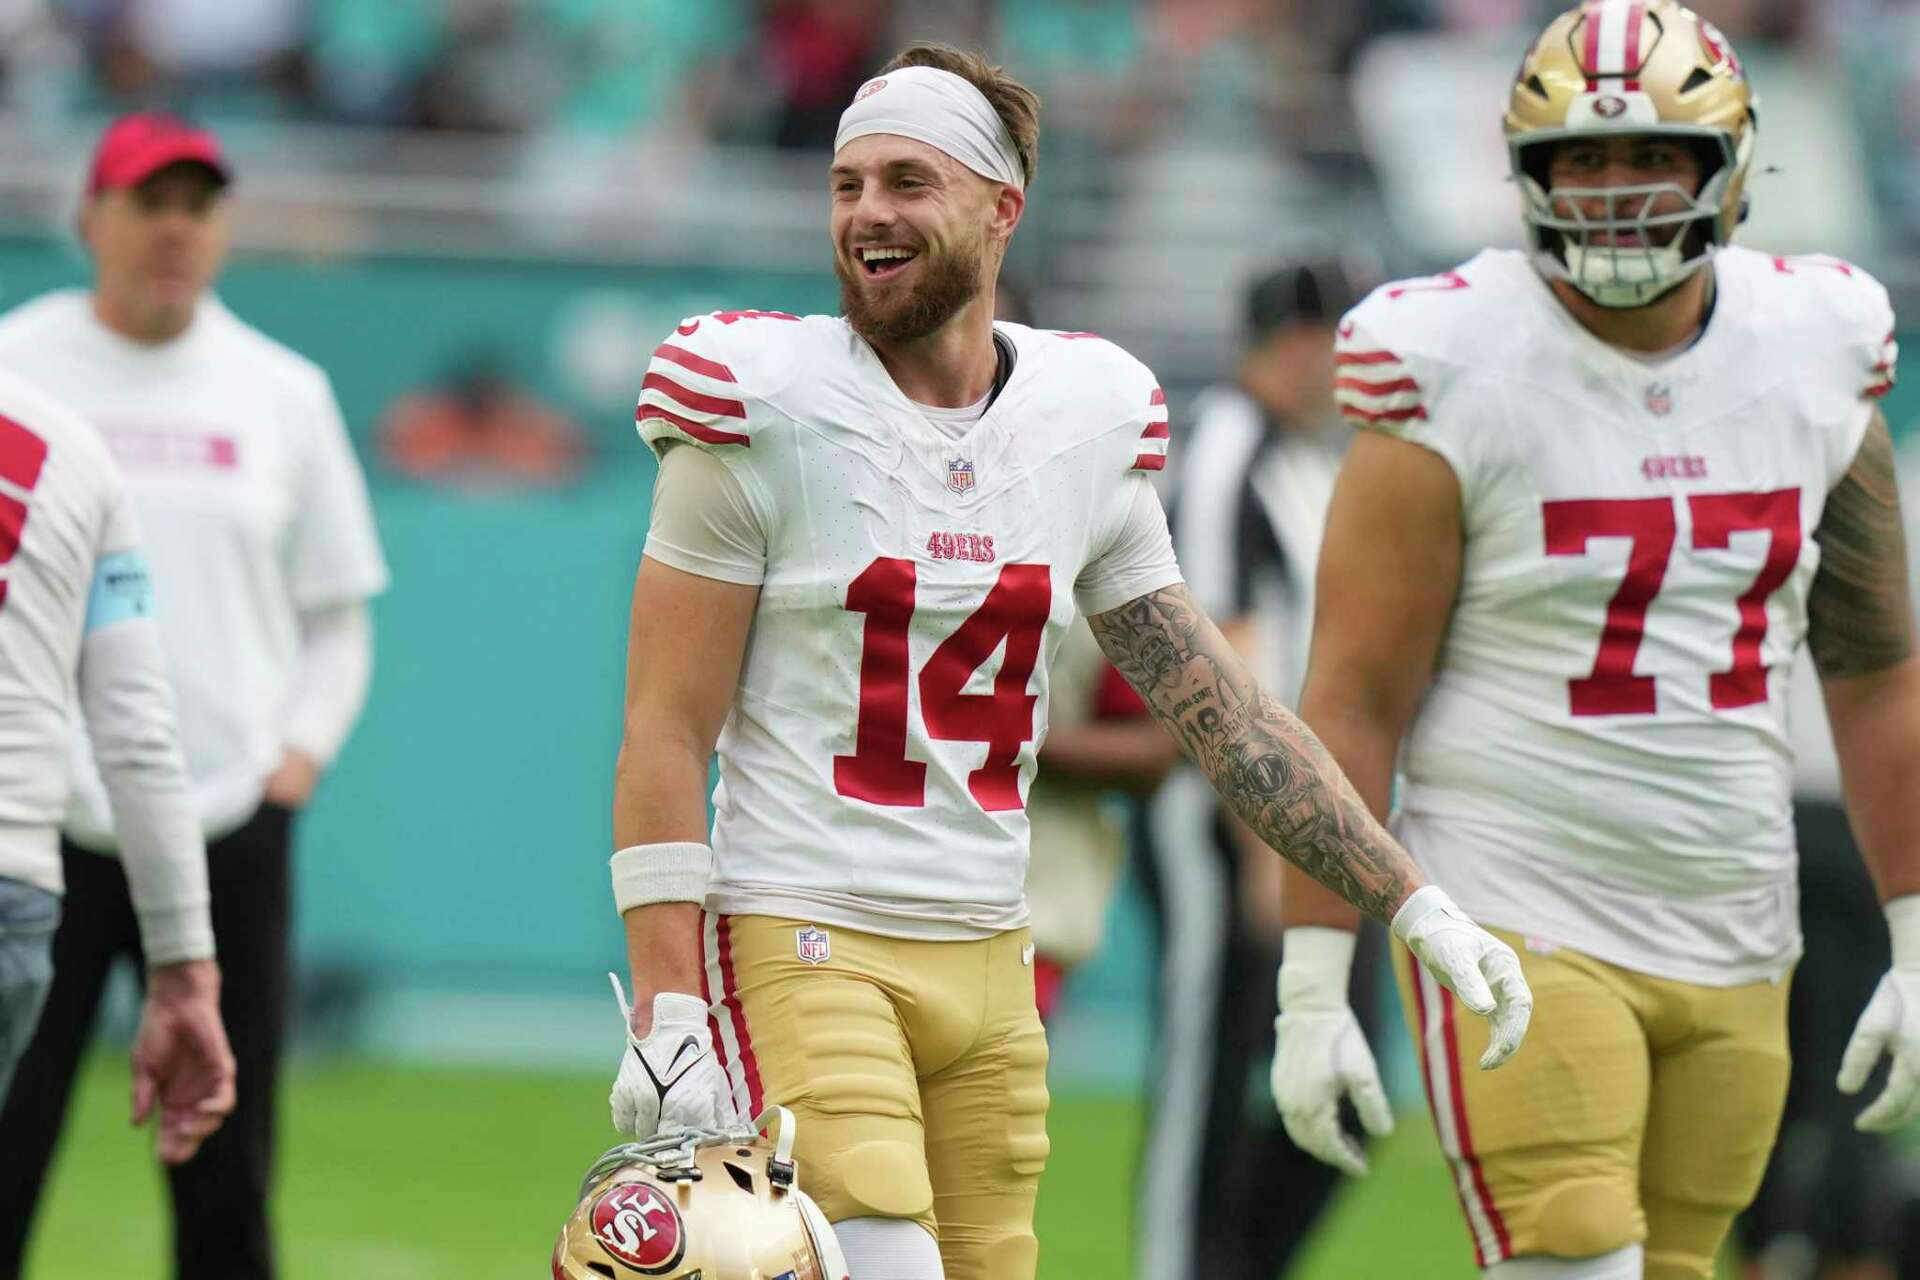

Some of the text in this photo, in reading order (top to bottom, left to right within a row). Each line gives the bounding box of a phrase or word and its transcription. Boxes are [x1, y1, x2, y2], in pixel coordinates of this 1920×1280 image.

[927, 531, 995, 562] 49ERS
[1542, 487, 1801, 717] 77
[833, 556, 1051, 812] 14
